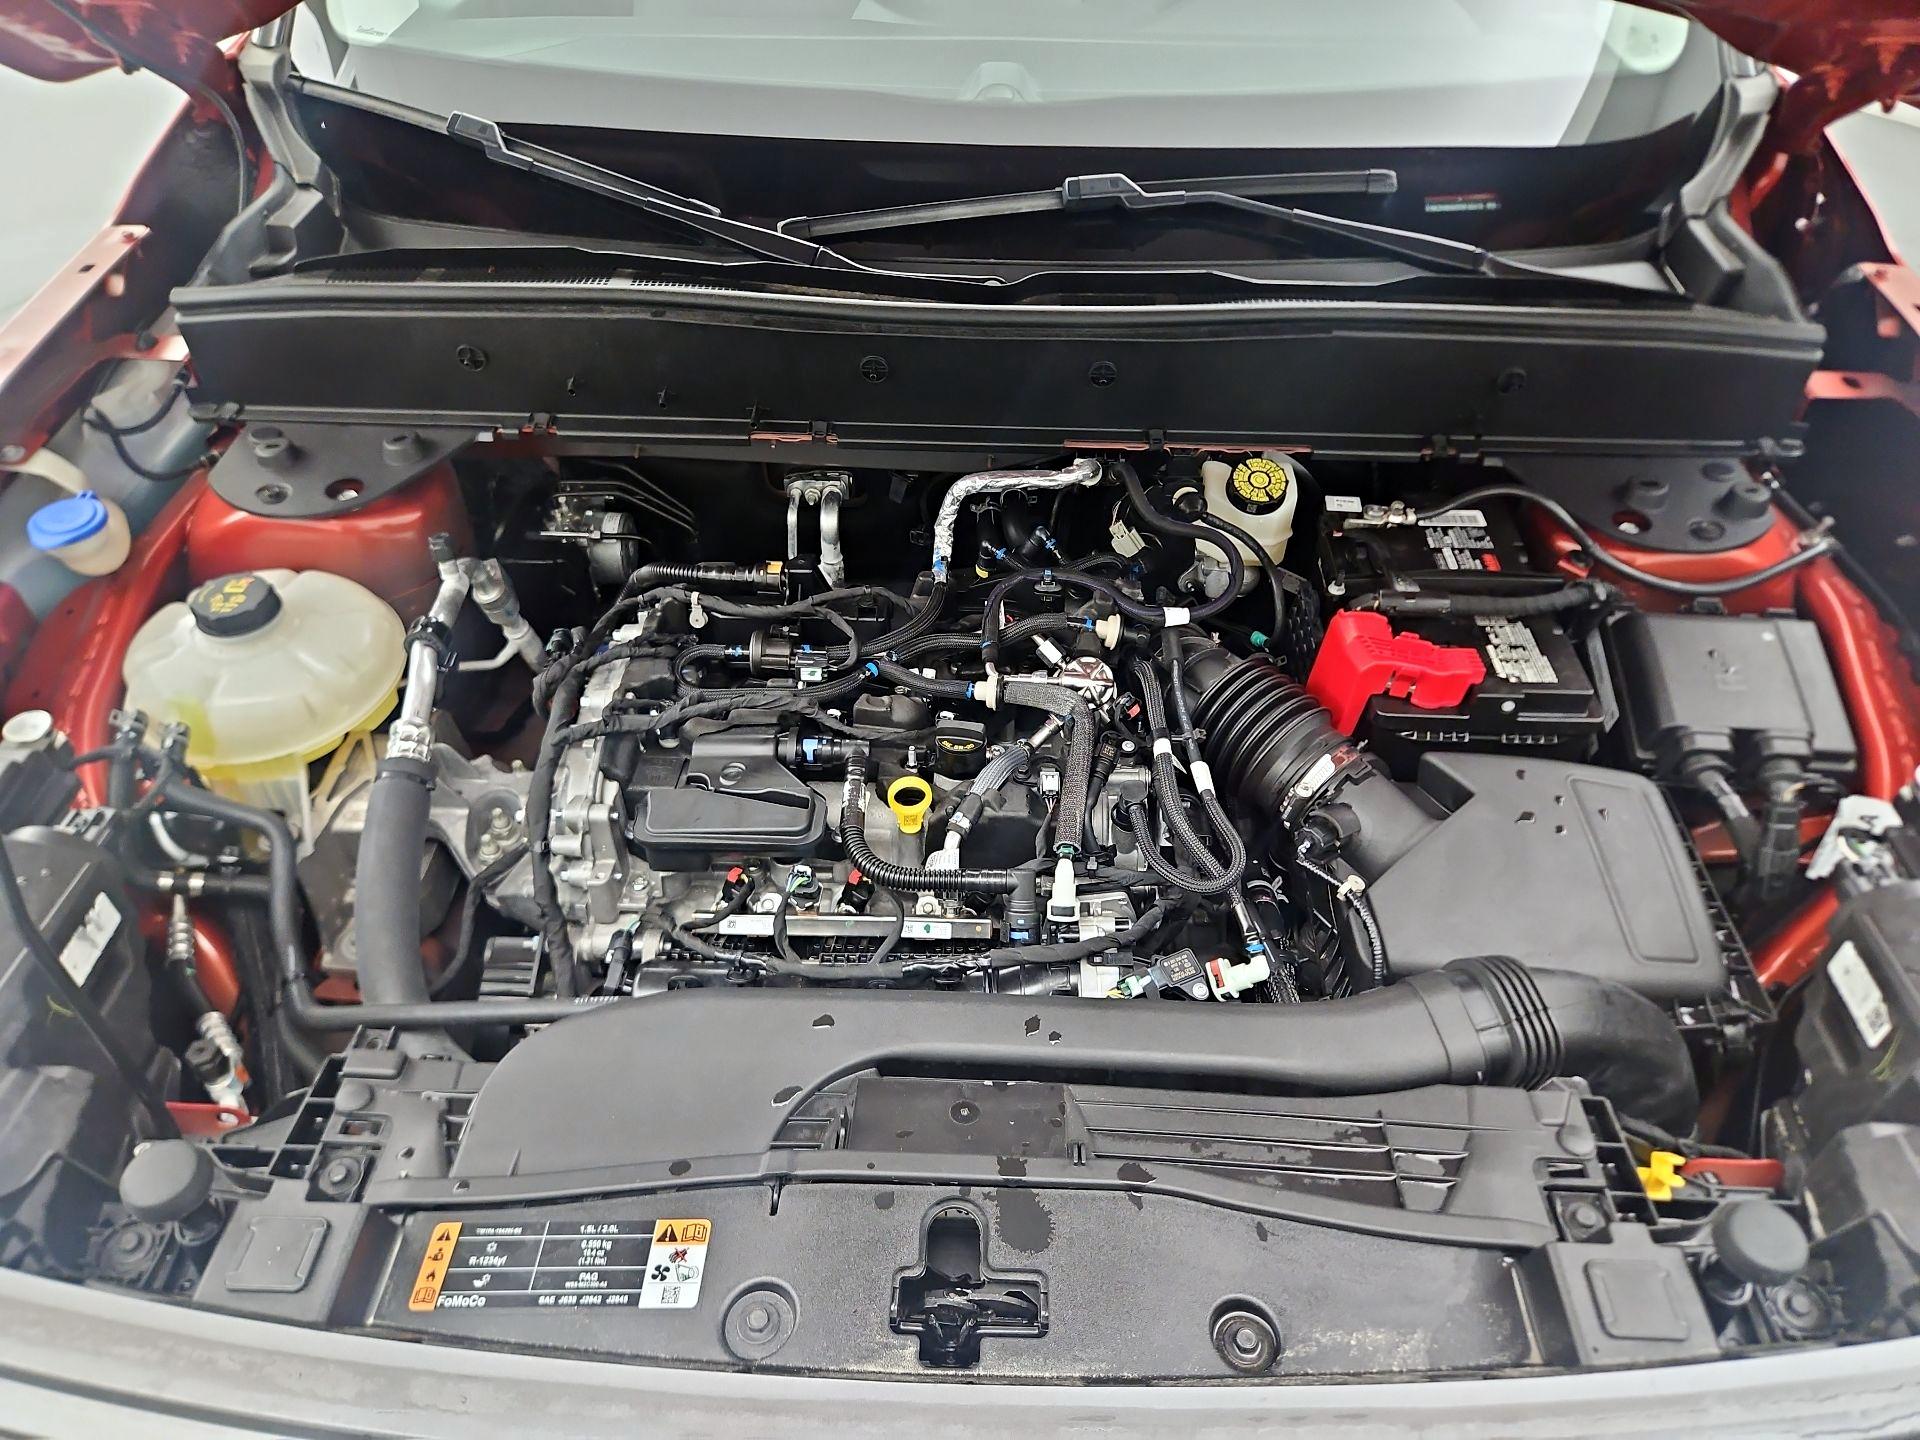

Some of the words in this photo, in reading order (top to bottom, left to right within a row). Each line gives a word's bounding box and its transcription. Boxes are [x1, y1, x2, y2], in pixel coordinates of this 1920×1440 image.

[602, 1239, 613, 1250] kg
[468, 1255, 508, 1267] R-1234yf
[579, 1272, 599, 1281] PAG
[437, 1294, 487, 1308] FoMoCo
[539, 1296, 557, 1305] SAE
